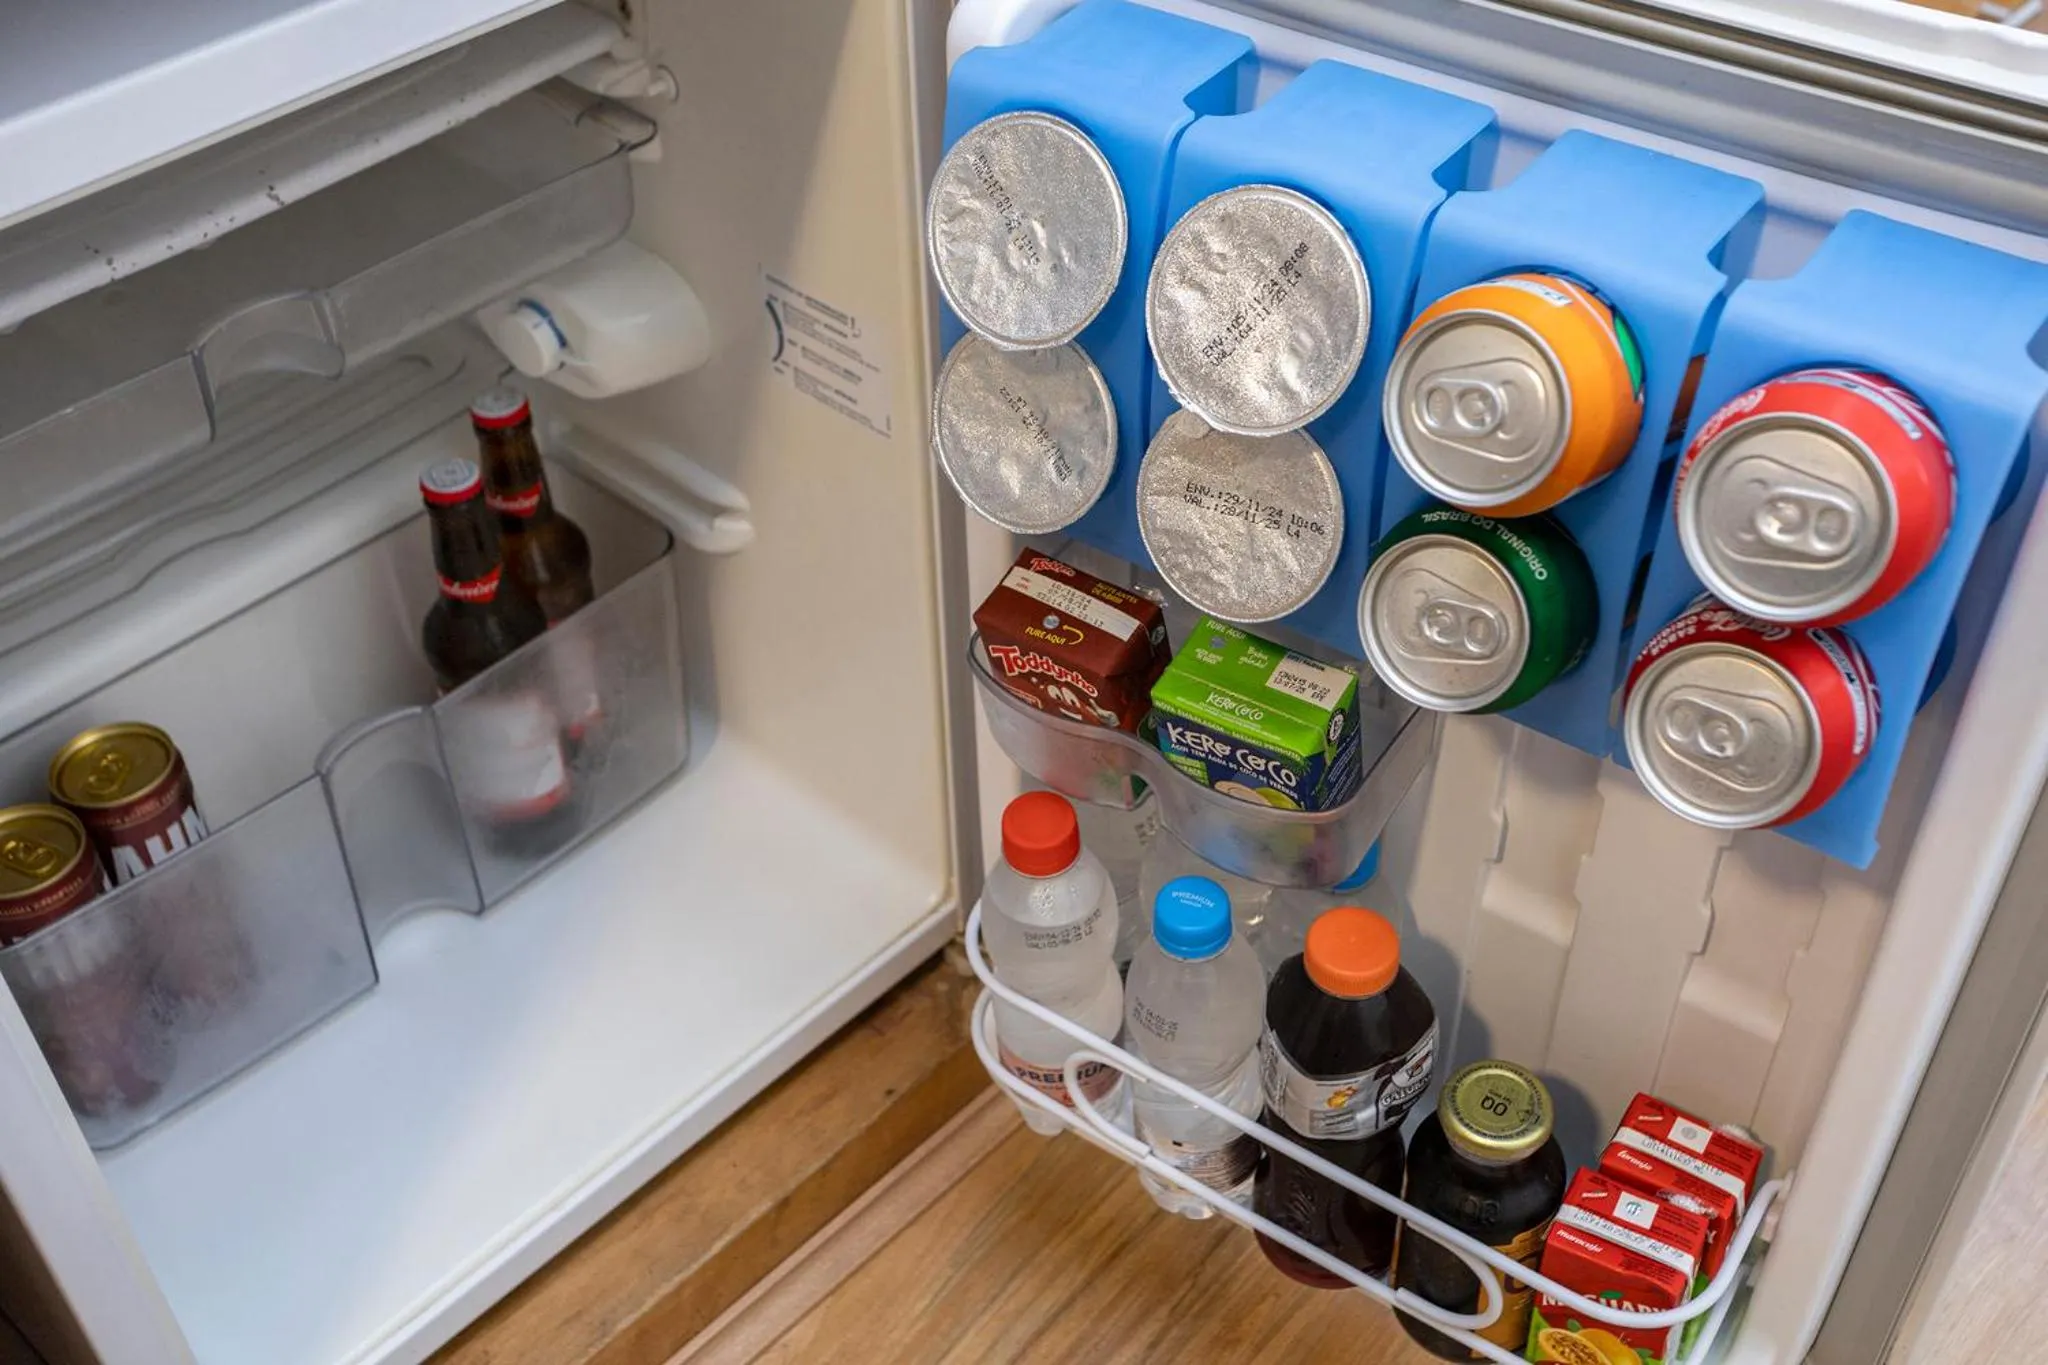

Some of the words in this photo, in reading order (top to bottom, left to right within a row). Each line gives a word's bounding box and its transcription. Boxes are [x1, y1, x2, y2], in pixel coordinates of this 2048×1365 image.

[1184, 494, 1281, 530] VAL.:28/11/25
[1287, 524, 1301, 539] L4
[1186, 481, 1283, 519] ENV.:29/11/24
[1290, 514, 1325, 536] 10:06
[1422, 509, 1470, 524] BRASIL
[1472, 516, 1496, 531] DO
[1496, 528, 1548, 581] ORIGINAL
[1025, 626, 1046, 641] FURE
[1045, 633, 1066, 646] AQUI
[989, 645, 1099, 698] Toddynho
[1015, 1063, 1110, 1083] PREIU
